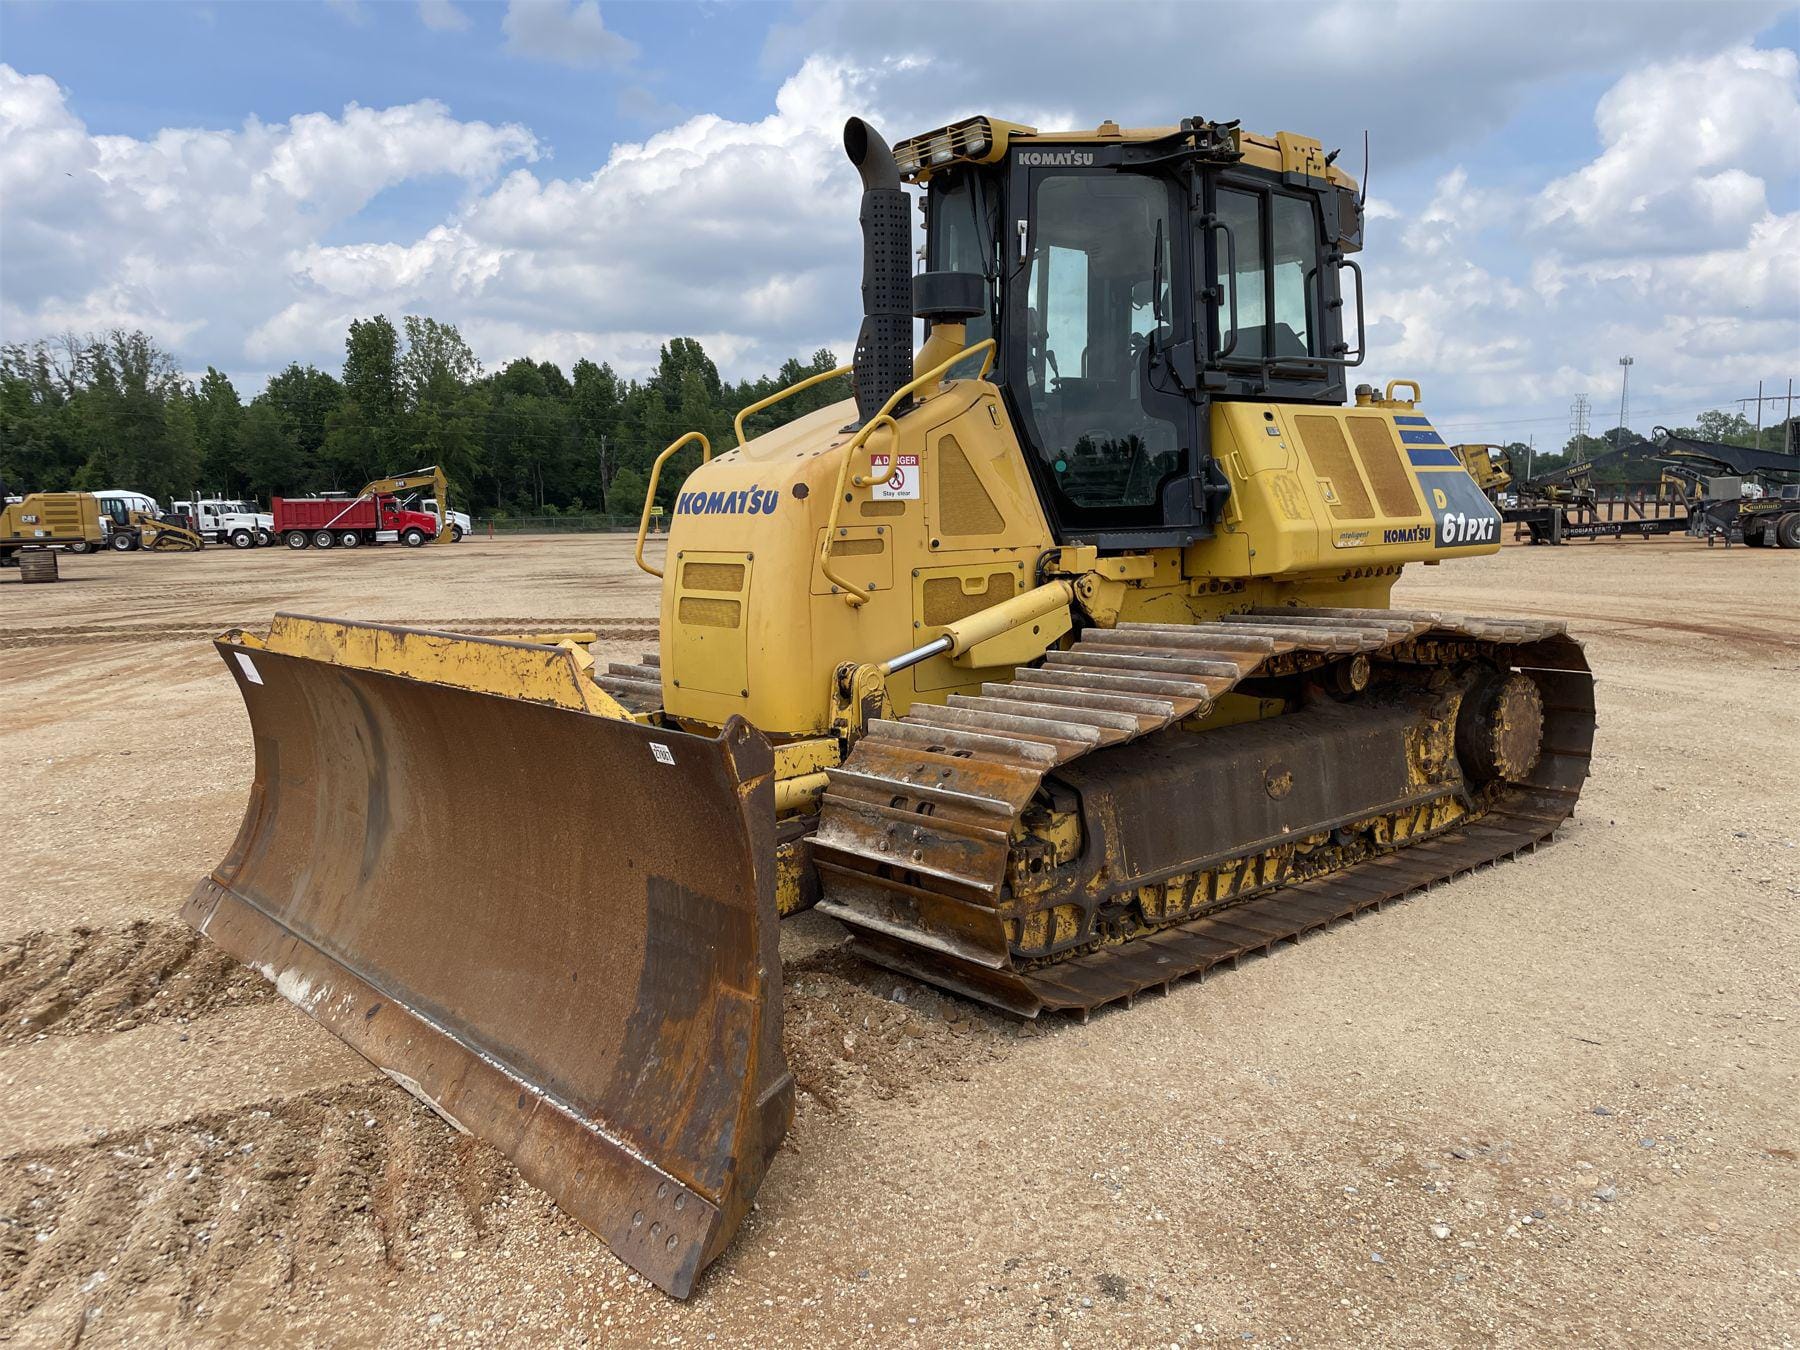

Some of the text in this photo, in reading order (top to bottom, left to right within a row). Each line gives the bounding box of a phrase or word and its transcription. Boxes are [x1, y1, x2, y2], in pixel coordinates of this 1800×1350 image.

[1018, 149, 1093, 166] KOMATSU
[883, 456, 916, 465] DNGER
[677, 483, 780, 515] KOMATSU
[1738, 503, 1778, 513] Kaufman
[1383, 524, 1431, 543] KOMATSU
[1442, 512, 1495, 544] 61PXi
